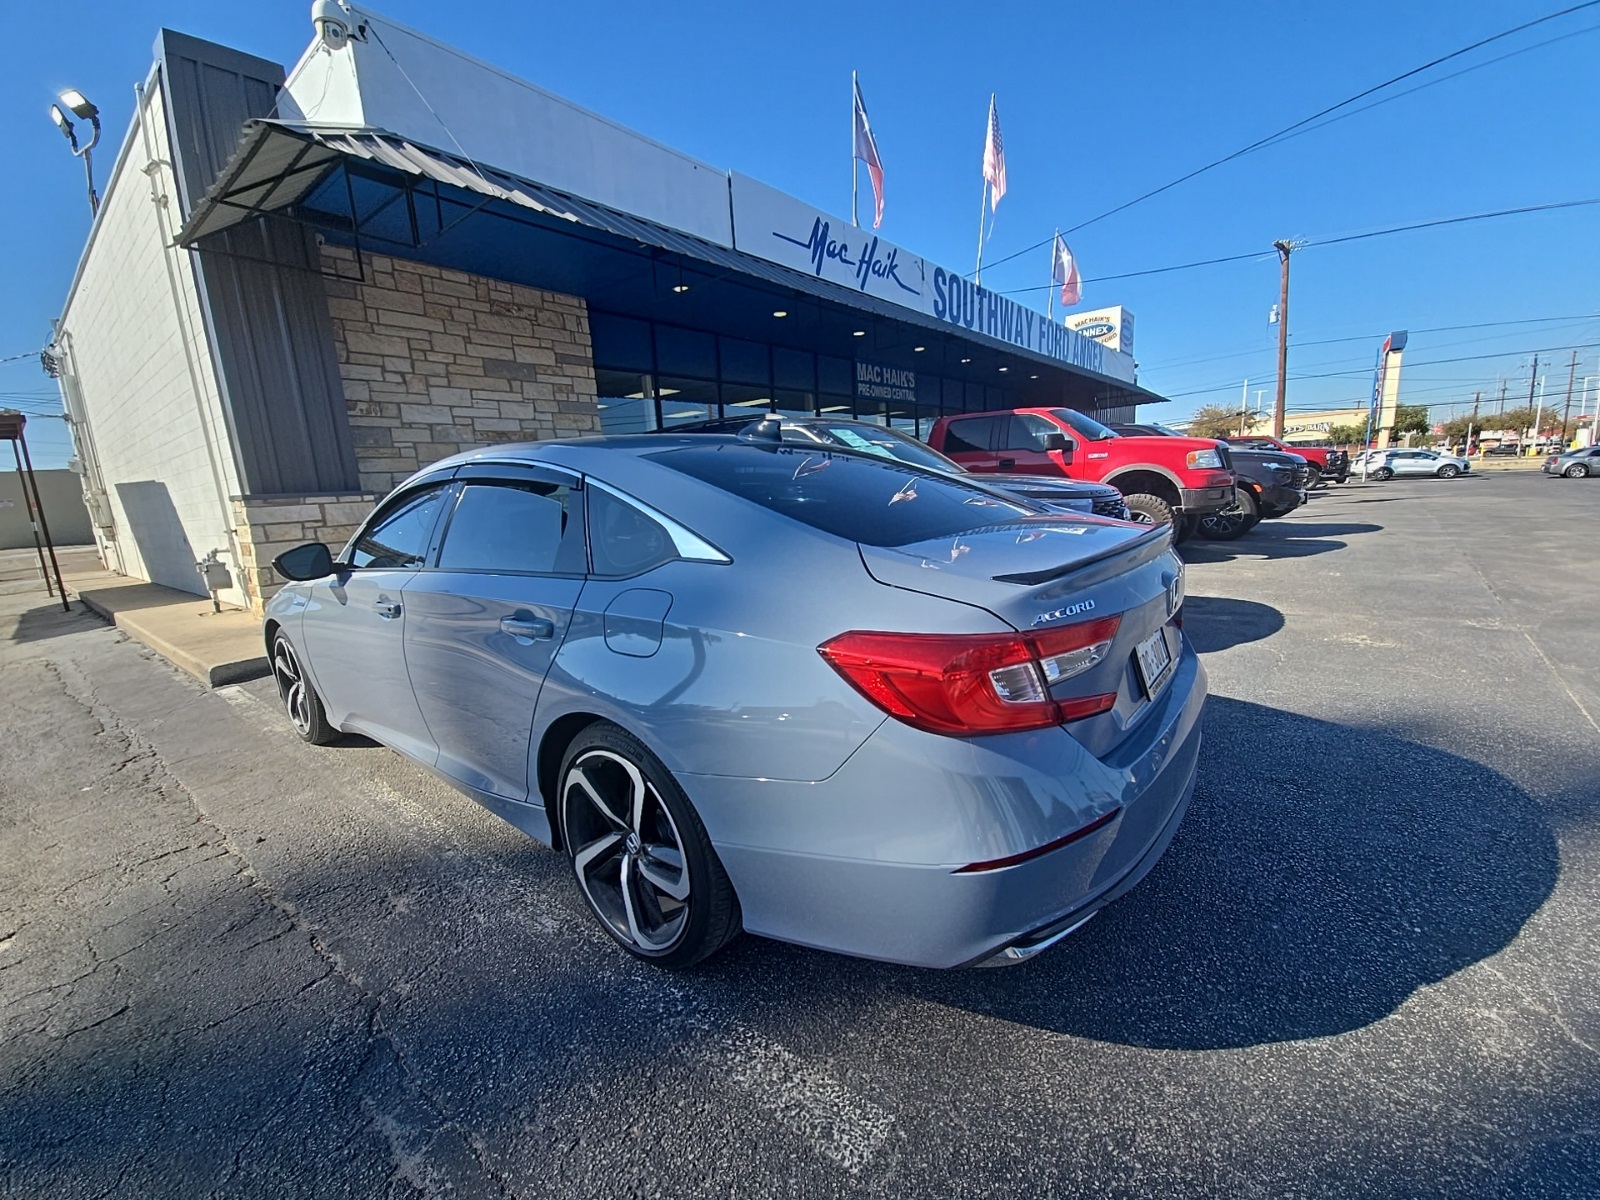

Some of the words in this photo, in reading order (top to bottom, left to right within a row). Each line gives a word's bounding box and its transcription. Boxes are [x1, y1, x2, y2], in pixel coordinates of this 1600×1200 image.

[772, 216, 855, 275] Mac
[856, 235, 920, 295] Haik
[933, 266, 1034, 348] SOUTHWAY
[1038, 315, 1069, 362] FORD
[1072, 332, 1104, 374] ANNEX
[1074, 318, 1088, 328] MAC
[856, 362, 882, 383] MAC
[882, 367, 915, 388] HAIK'S
[857, 383, 892, 399] PRE-OWNED
[892, 387, 916, 402] CENTRAL
[1029, 599, 1095, 626] ACCORD
